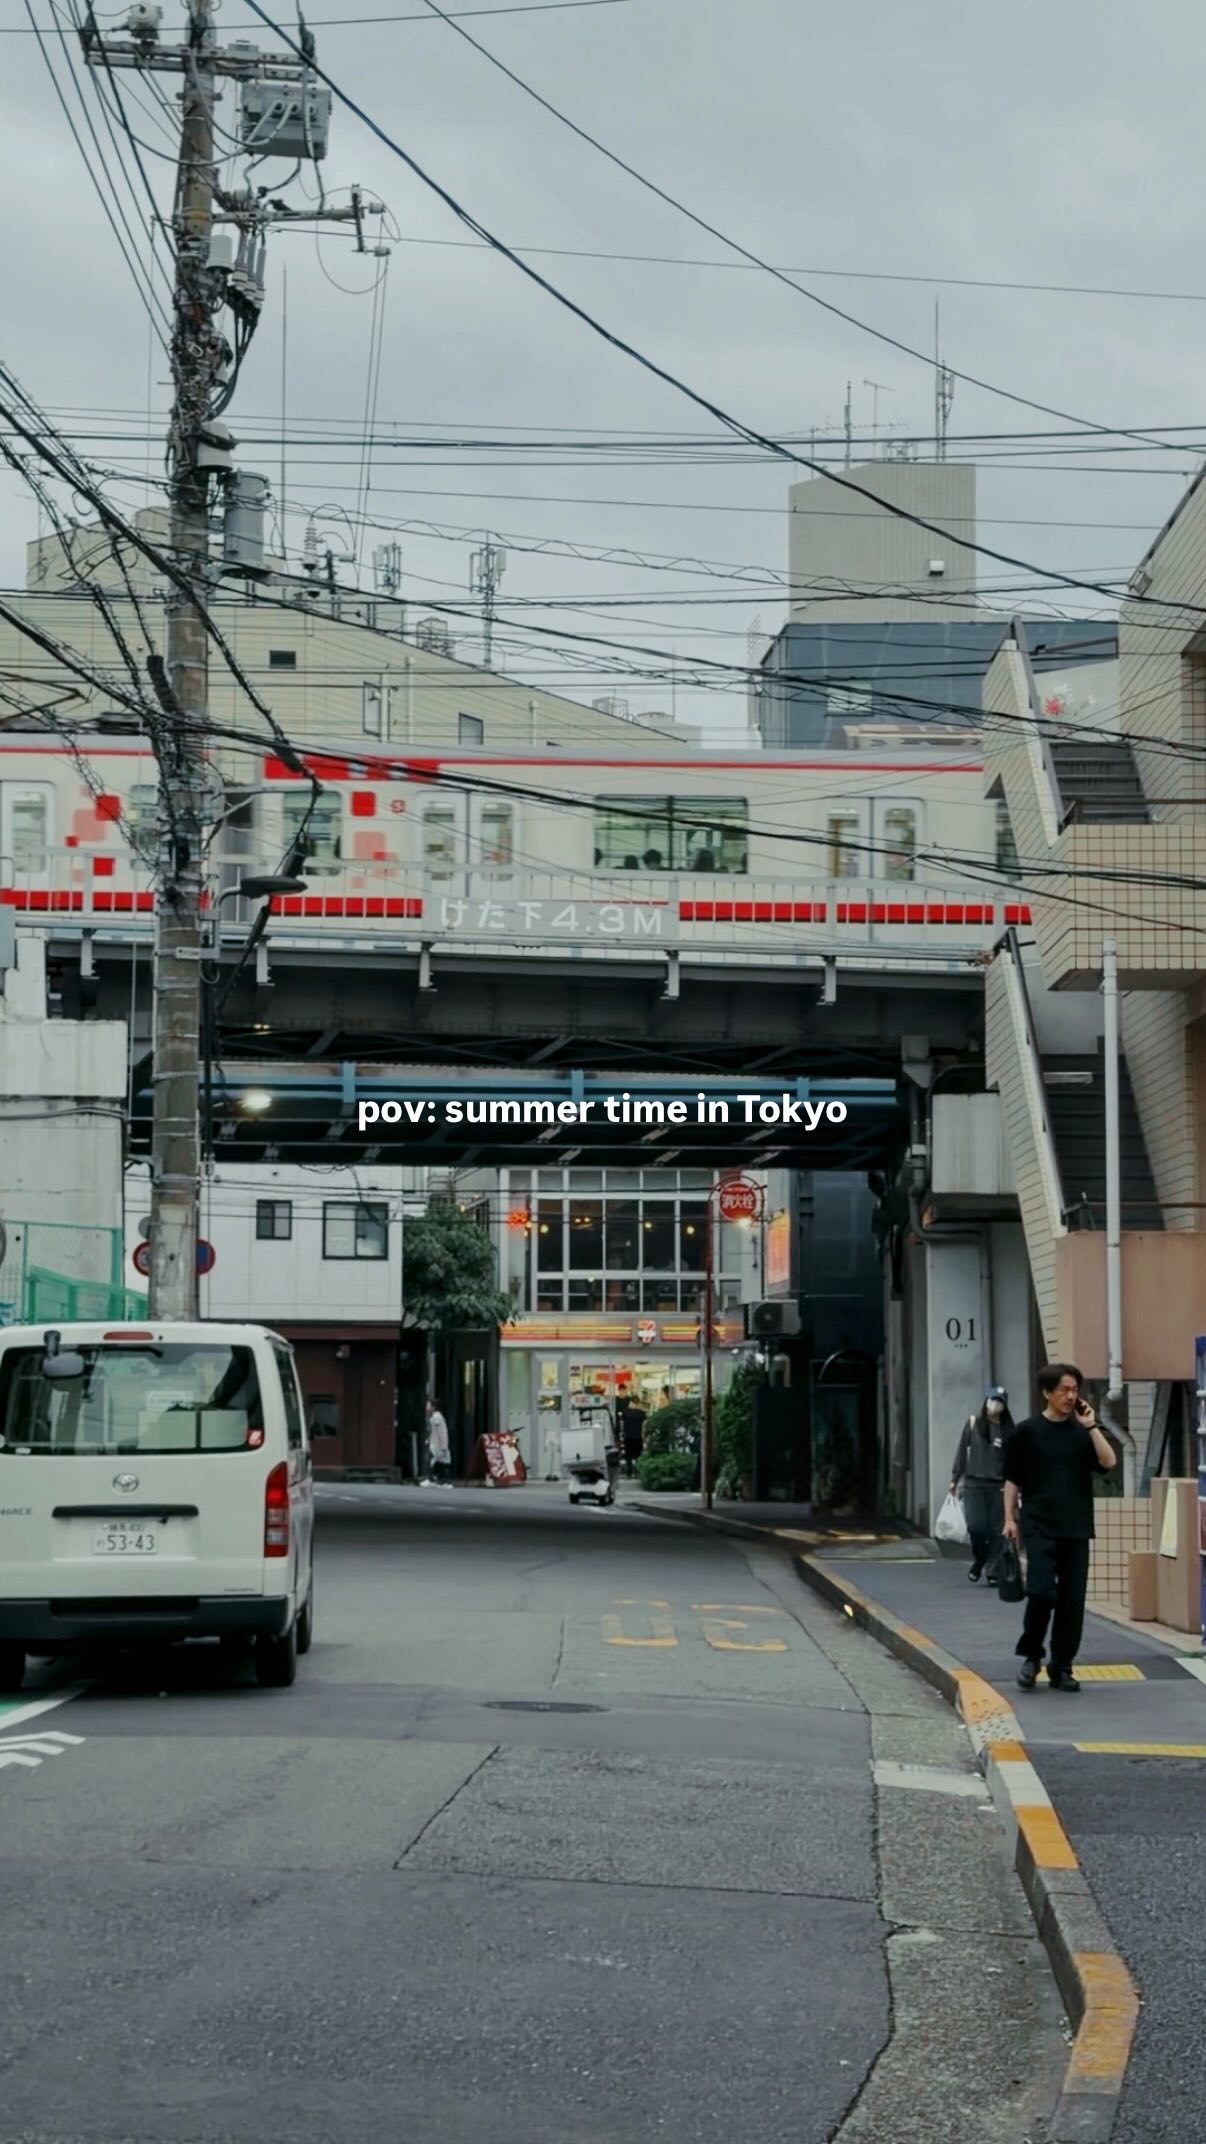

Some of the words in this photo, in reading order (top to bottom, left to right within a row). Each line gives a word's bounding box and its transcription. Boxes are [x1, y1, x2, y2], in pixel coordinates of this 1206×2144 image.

[722, 1194, 754, 1209] 消火栓
[945, 1317, 977, 1342] 01
